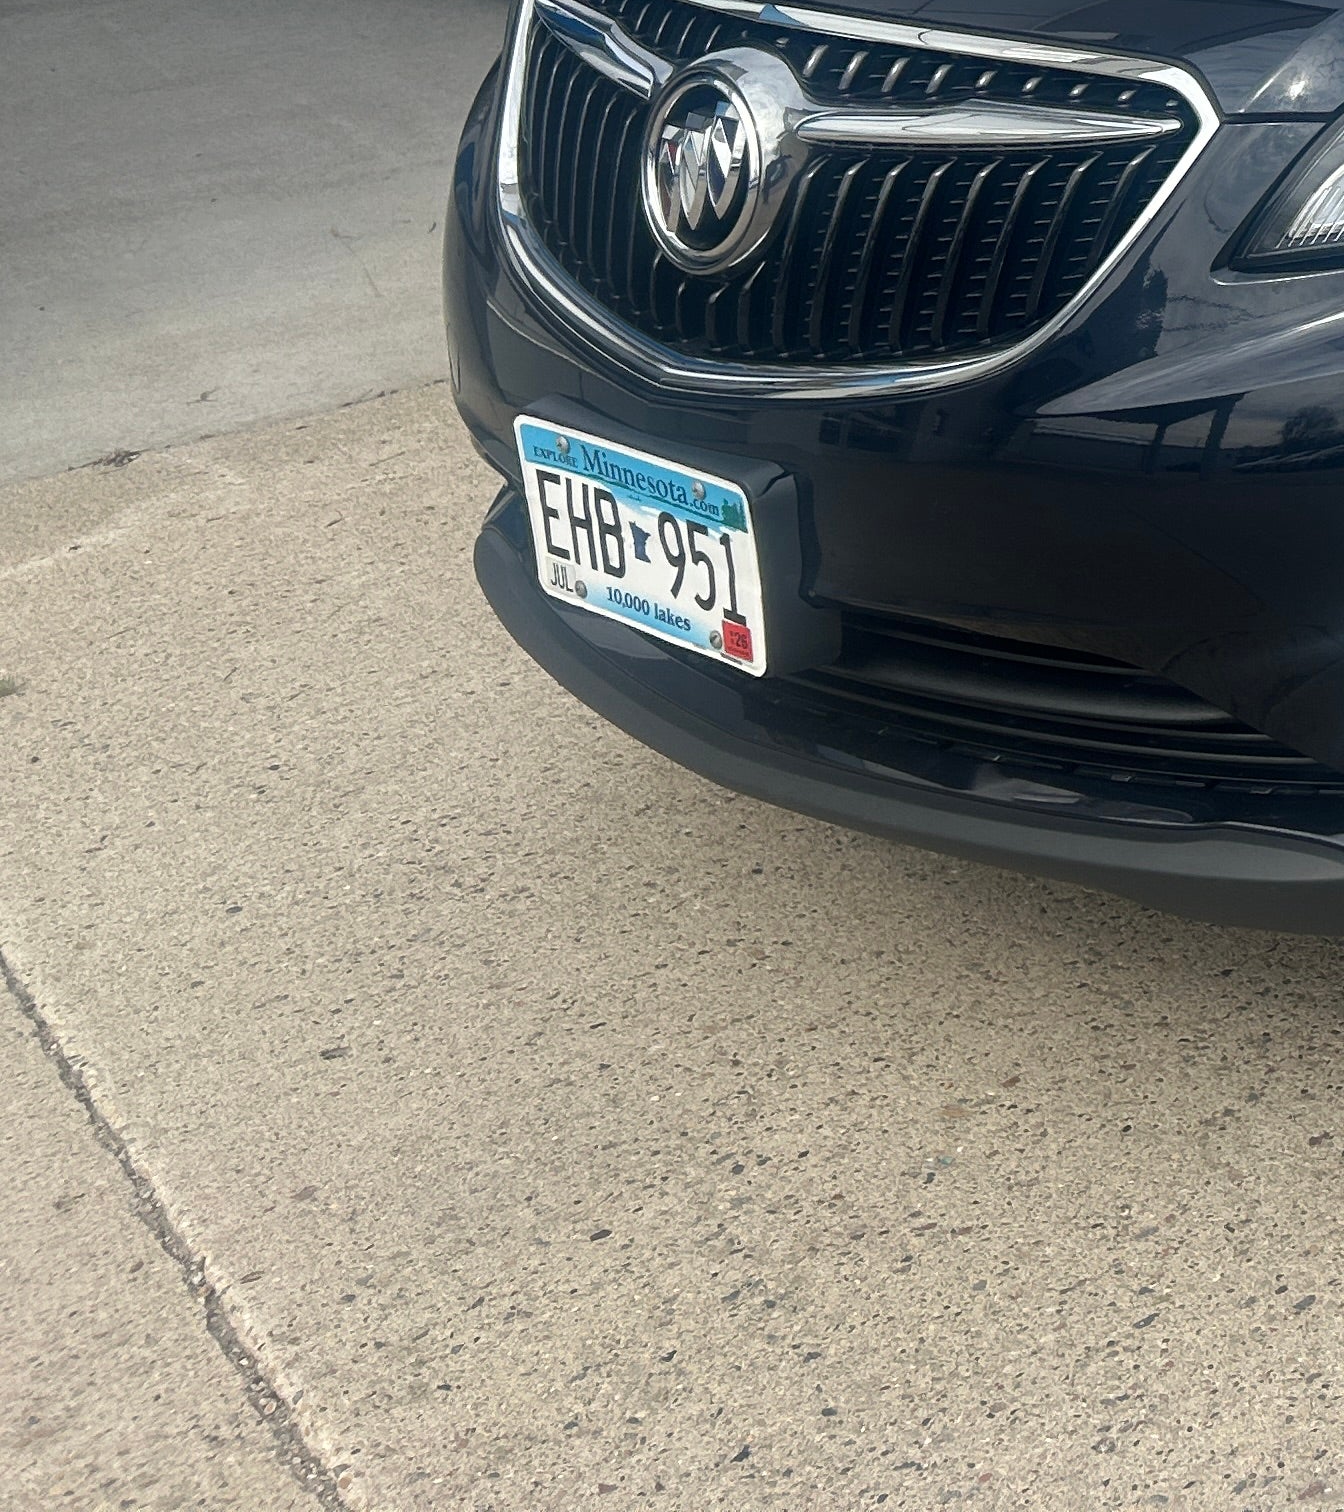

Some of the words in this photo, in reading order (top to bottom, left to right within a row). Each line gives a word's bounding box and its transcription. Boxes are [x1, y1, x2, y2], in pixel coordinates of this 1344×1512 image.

[532, 445, 578, 469] EXPLORE
[536, 469, 626, 579] EHB
[658, 511, 747, 627] 951
[550, 562, 574, 593] JUL
[606, 586, 650, 616] 10,000
[654, 603, 692, 632] lakes
